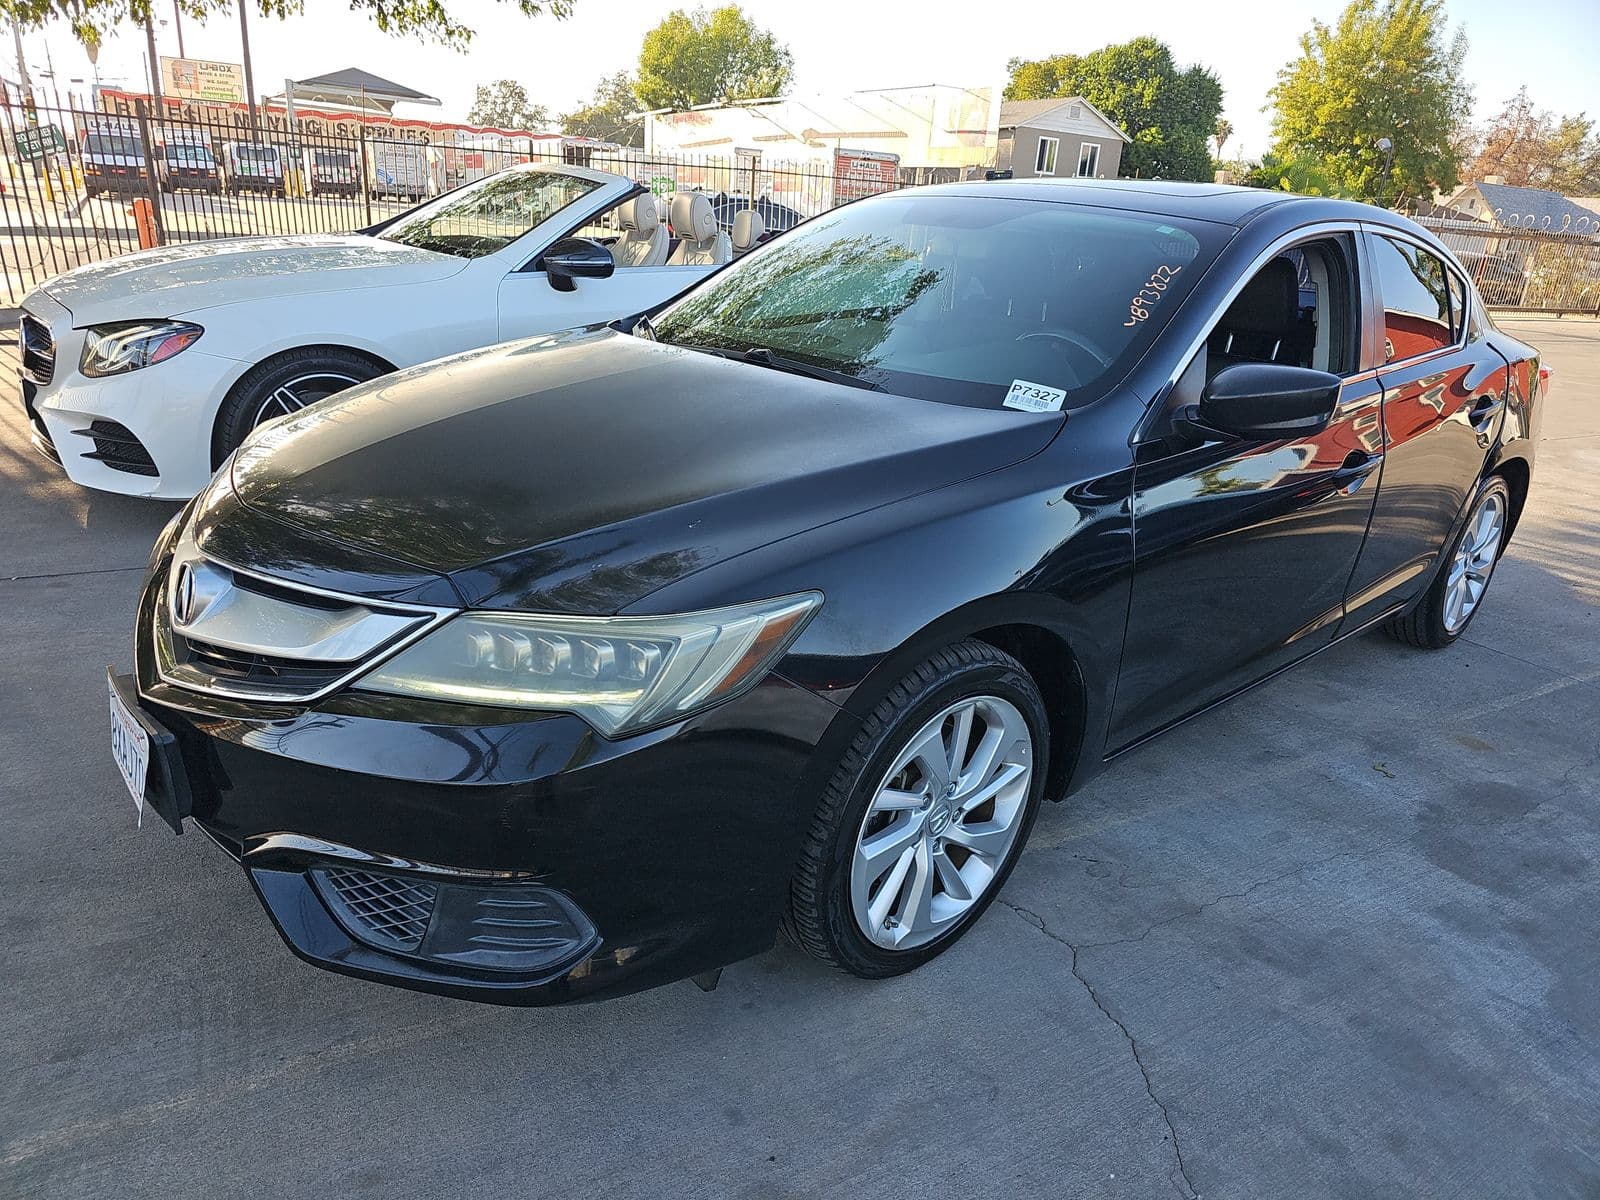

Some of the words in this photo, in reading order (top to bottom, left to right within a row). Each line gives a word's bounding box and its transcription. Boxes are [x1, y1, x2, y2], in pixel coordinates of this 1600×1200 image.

[199, 63, 233, 73] U-BOX
[89, 119, 139, 132] U-HAUL
[851, 161, 880, 170] U-HAUL
[1123, 265, 1182, 327] 4893822
[1011, 384, 1061, 402] P7327
